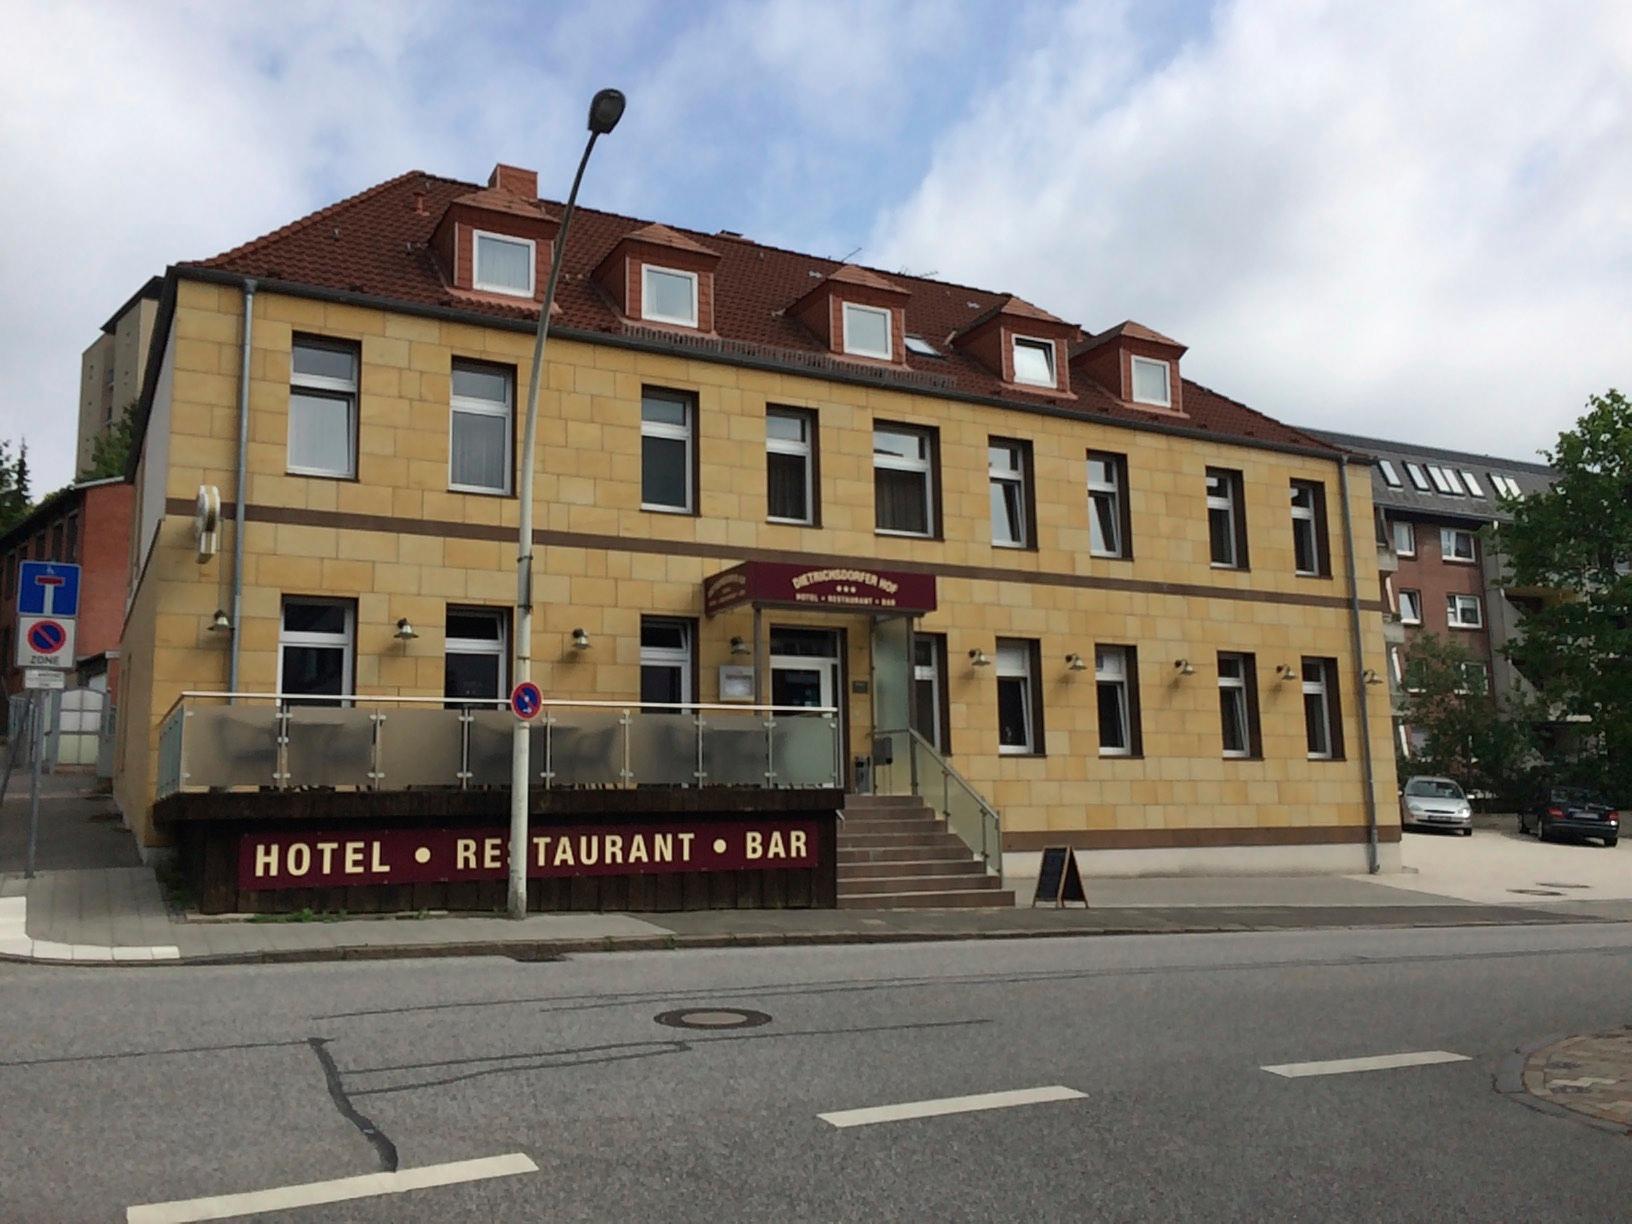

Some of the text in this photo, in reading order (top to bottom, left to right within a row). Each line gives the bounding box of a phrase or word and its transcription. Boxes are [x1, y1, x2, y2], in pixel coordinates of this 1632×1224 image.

[879, 577, 898, 594] HOF
[795, 593, 896, 606] HOTEL RESTAURANT BAR
[30, 655, 59, 665] ZONE
[255, 830, 807, 877] HOTEL RETAURANT BAR
